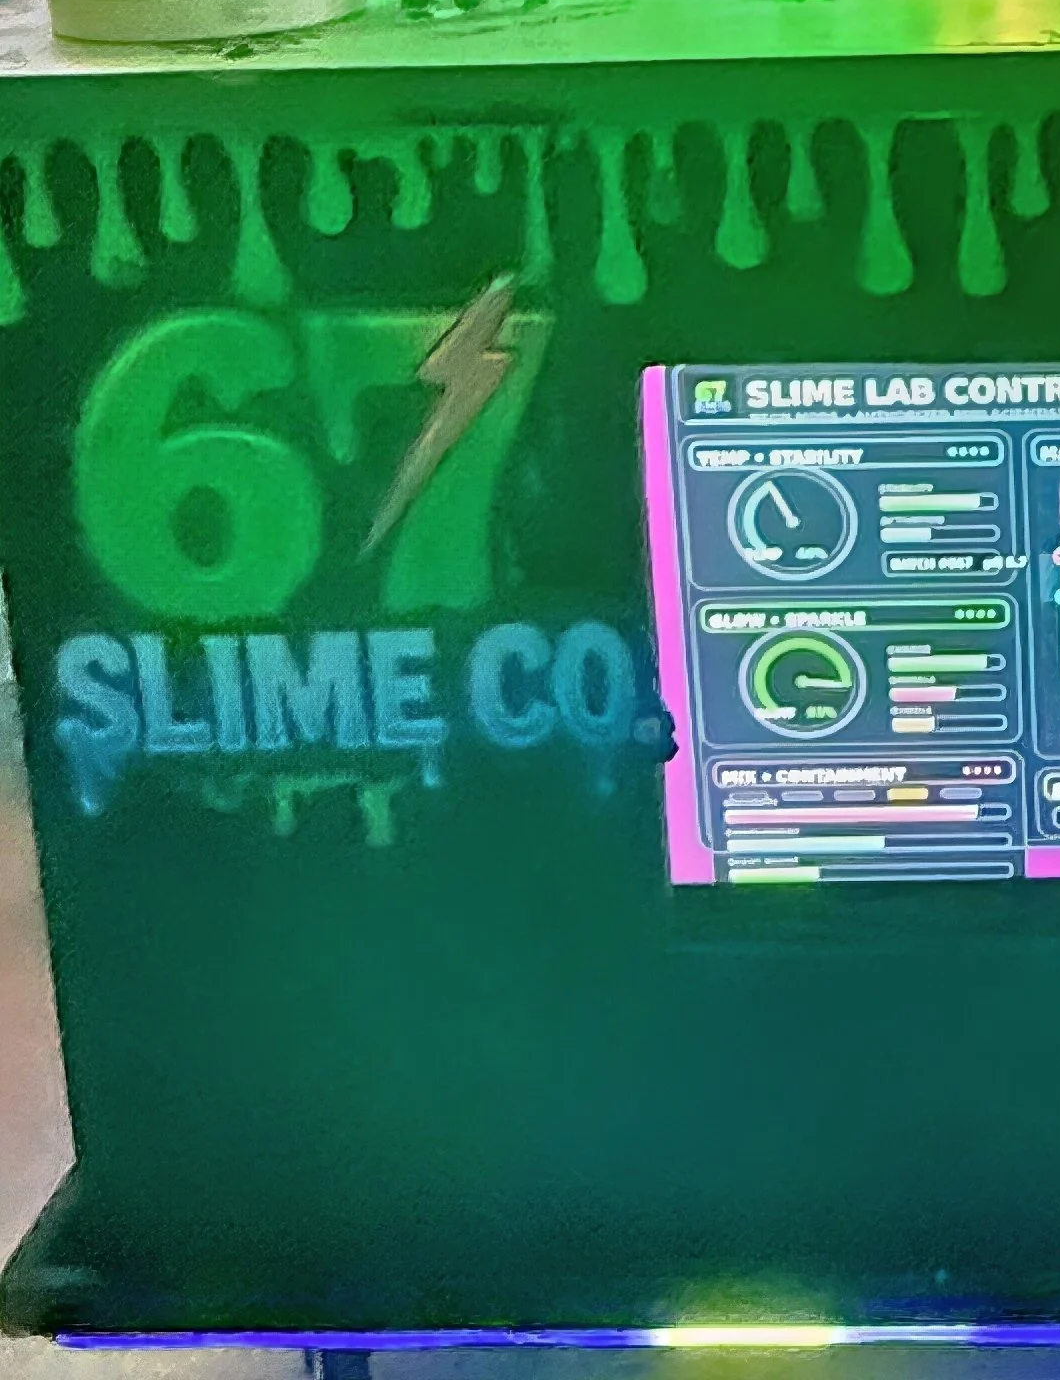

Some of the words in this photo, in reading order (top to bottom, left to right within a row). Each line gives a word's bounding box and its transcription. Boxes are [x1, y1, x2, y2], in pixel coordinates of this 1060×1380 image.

[746, 377, 856, 409] SLIME
[865, 376, 936, 406] LAB
[74, 304, 558, 621] 67
[55, 629, 446, 760] SLIME
